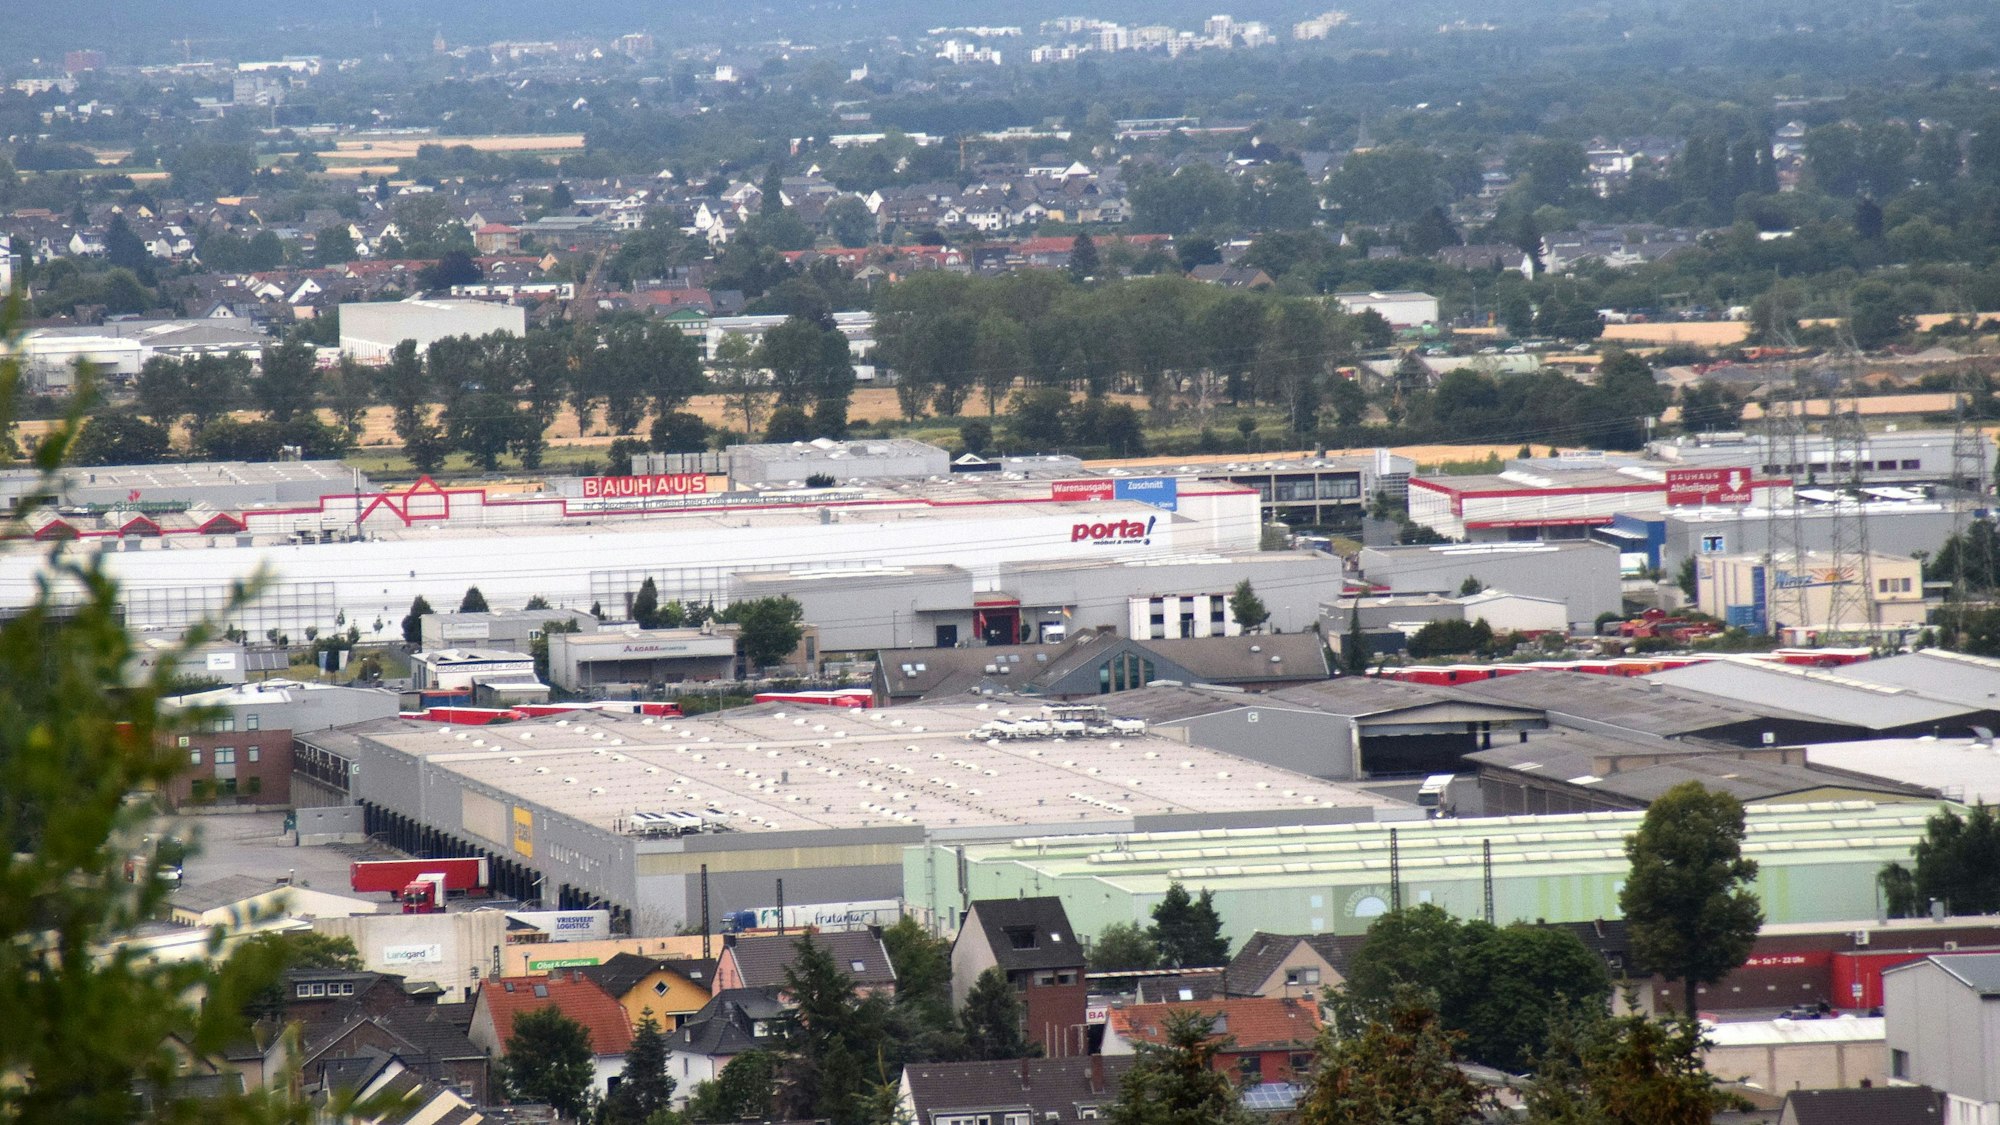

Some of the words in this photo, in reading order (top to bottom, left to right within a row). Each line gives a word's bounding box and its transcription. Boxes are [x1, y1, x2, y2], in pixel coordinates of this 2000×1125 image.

[1670, 472, 1719, 480] BAUHAUS
[585, 475, 704, 496] BAUHAUS
[1053, 482, 1112, 493] Warenausgabe
[1127, 481, 1164, 490] Zuschnitt
[1670, 482, 1720, 493] Abhollager
[387, 950, 426, 960] Landgard
